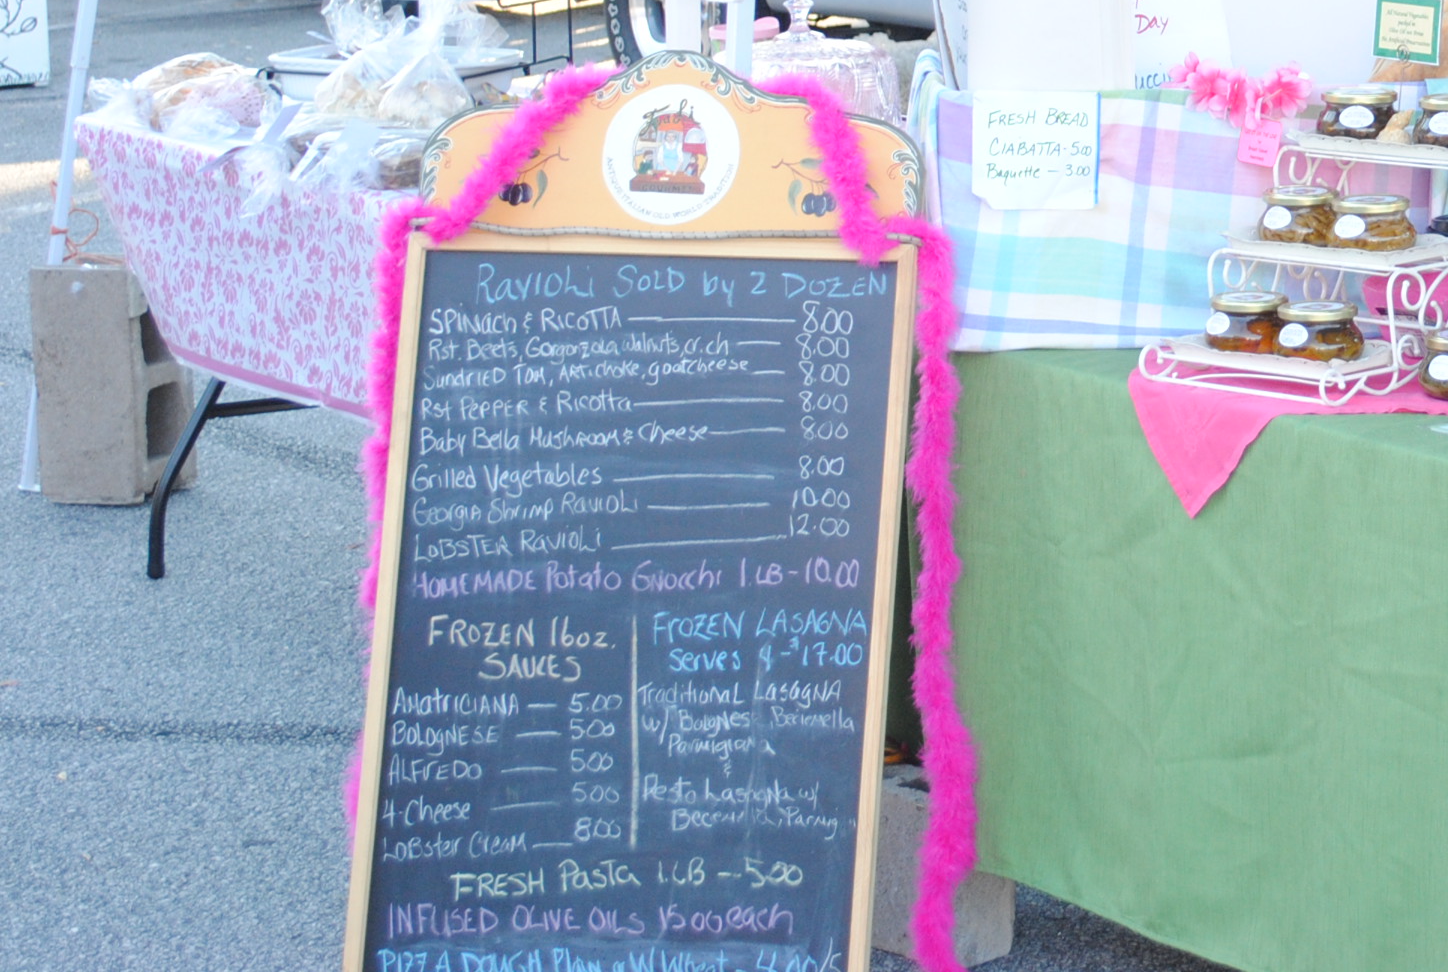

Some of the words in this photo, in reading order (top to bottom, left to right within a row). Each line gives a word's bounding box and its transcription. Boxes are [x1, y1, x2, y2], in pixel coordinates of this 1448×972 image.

[1134, 14, 1169, 35] Day
[988, 110, 1036, 129] FRESH
[1045, 108, 1089, 127] BREAD
[989, 137, 1061, 156] CIABATTA
[703, 270, 735, 308] by
[750, 271, 767, 295] 2
[795, 333, 850, 360] 8.00
[798, 360, 851, 387] 8.00
[421, 397, 451, 421] Rst
[557, 387, 633, 415] Ricotta
[798, 390, 849, 413] 8.00
[419, 427, 466, 457] Baby
[472, 426, 521, 451] Bella
[638, 420, 709, 444] Cheese
[412, 463, 476, 492] Grilled
[483, 460, 602, 498] Vegetables
[799, 455, 845, 480] 8.00
[789, 513, 850, 538] 12.00
[546, 560, 622, 593] Potato
[428, 614, 535, 647] FROZEN
[756, 607, 868, 637] LASAGNA
[478, 652, 582, 683] SAUCES
[568, 692, 623, 714] 5.00
[450, 867, 545, 902] FRESH
[388, 902, 499, 939] INFUSED
[512, 904, 581, 931] OLIVE
